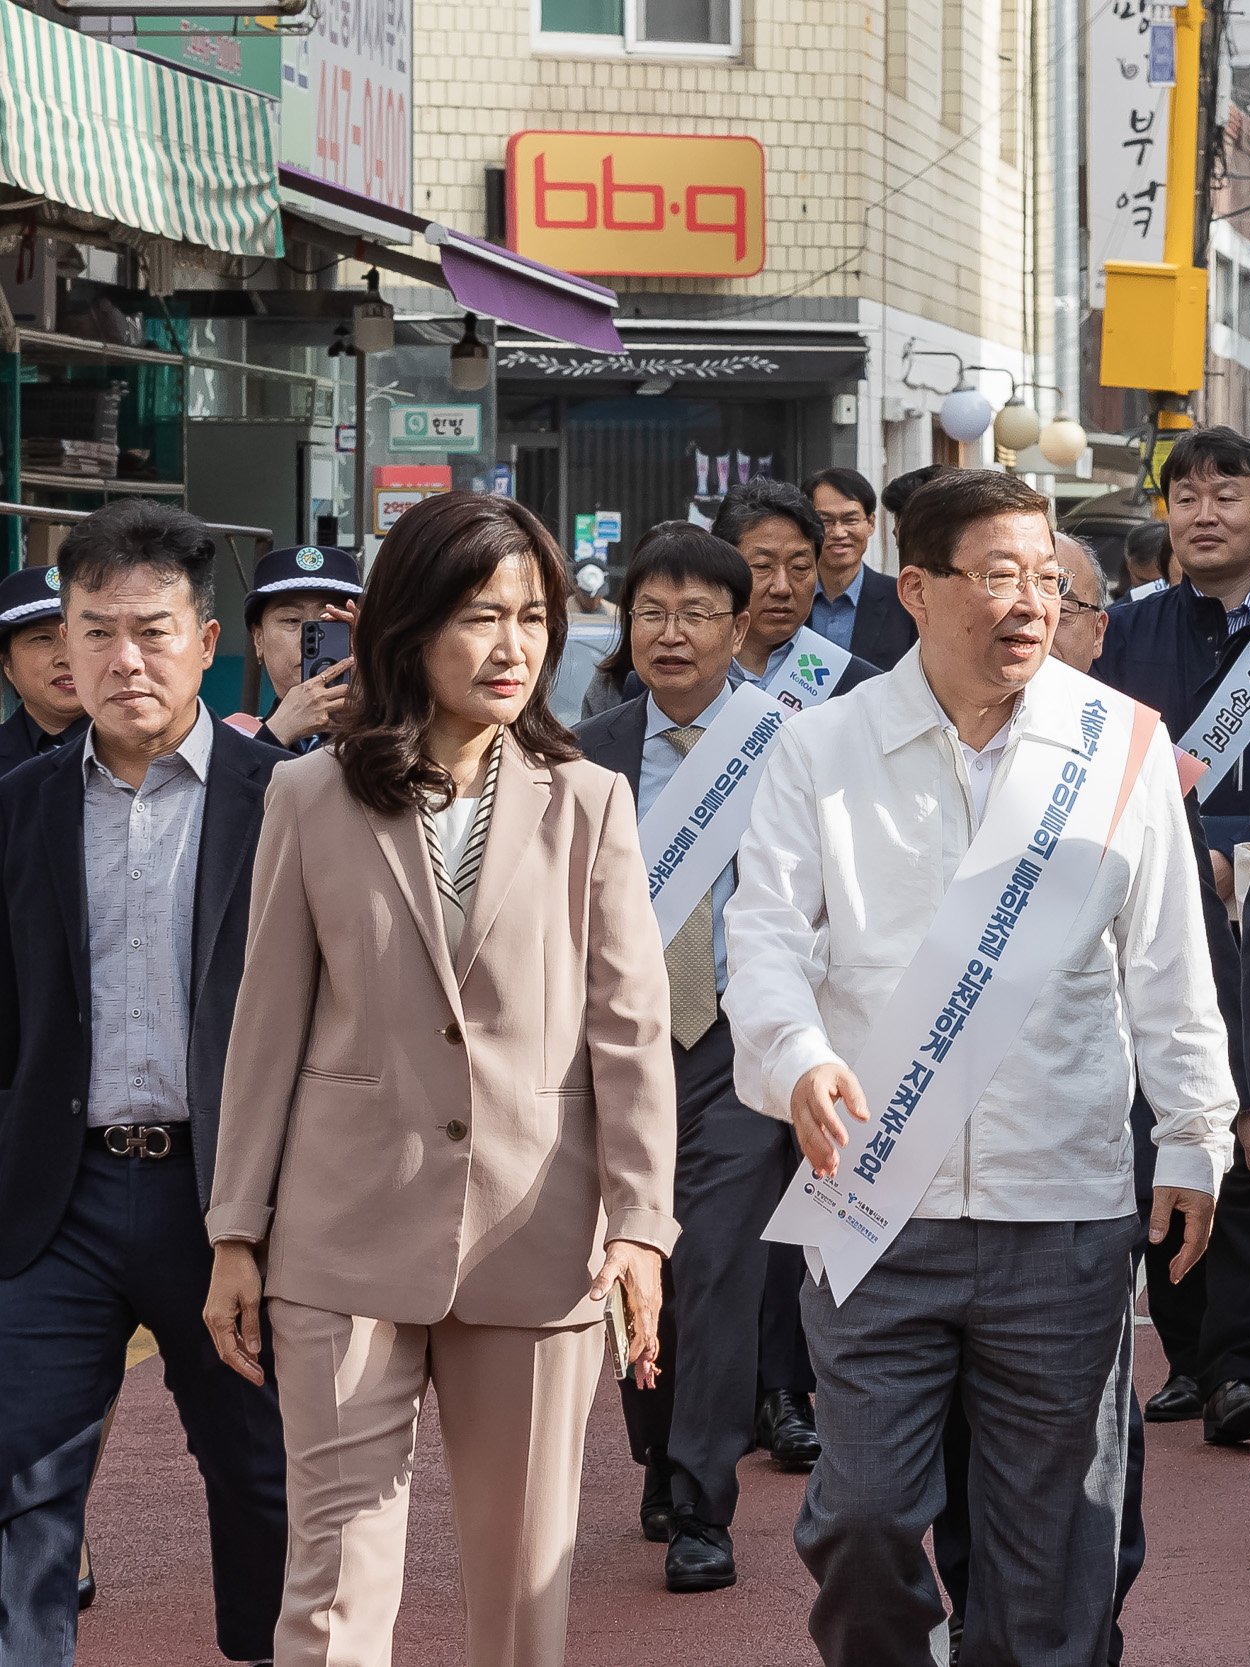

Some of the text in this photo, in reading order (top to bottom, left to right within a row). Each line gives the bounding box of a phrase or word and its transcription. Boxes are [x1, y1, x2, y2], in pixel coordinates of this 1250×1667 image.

[316, 58, 407, 211] 447-0400
[789, 671, 819, 697] KoROAD
[740, 711, 782, 761] 소중한
[688, 758, 749, 830] 아이들의
[1027, 762, 1086, 861] 아이들의
[978, 858, 1042, 961] 등하굣길
[920, 959, 993, 1063] 안전하게
[855, 1061, 933, 1182] 지켜주세요
